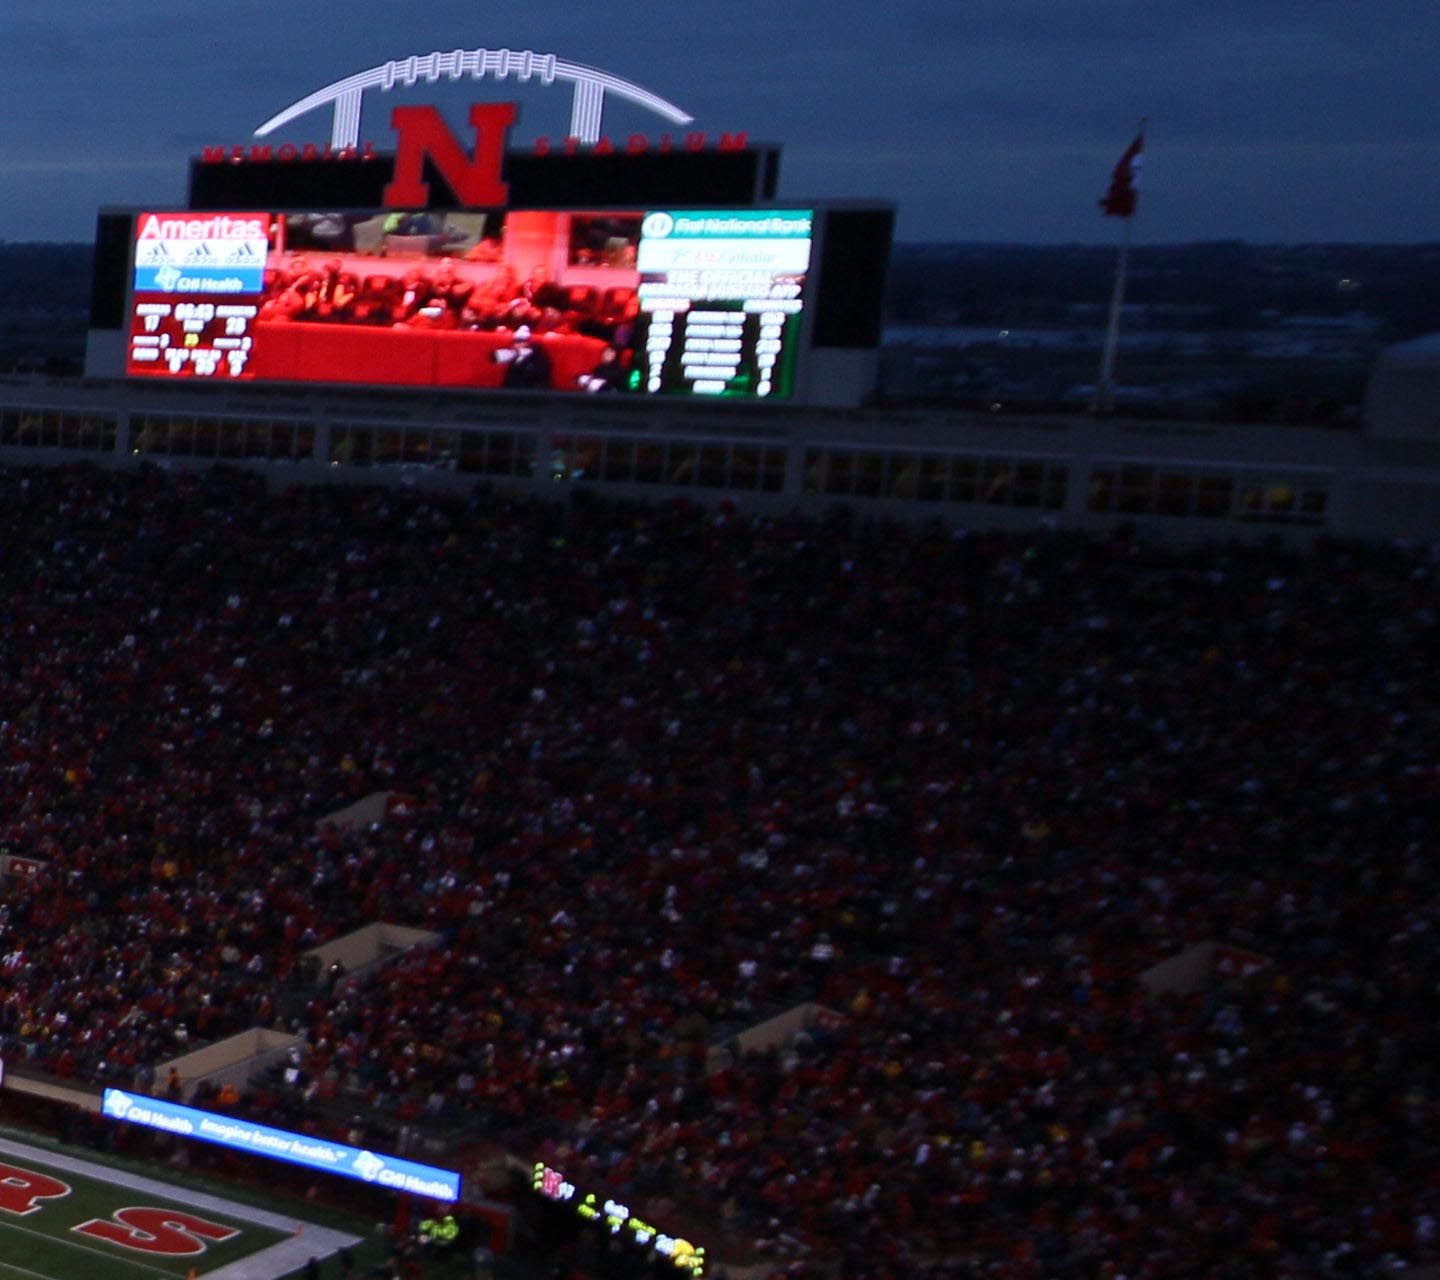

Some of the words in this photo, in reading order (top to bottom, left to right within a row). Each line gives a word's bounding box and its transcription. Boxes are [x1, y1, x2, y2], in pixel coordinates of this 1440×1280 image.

[202, 142, 379, 164] MEMORIAL
[534, 132, 750, 156] STADIUM
[383, 100, 518, 207] N
[140, 214, 263, 239] Ameritas
[129, 1107, 152, 1124] CHI
[152, 1112, 194, 1135] Health
[200, 1119, 251, 1144] Imagine
[252, 1131, 290, 1151] better
[379, 1169, 405, 1188] CHI
[406, 1173, 454, 1199] Health
